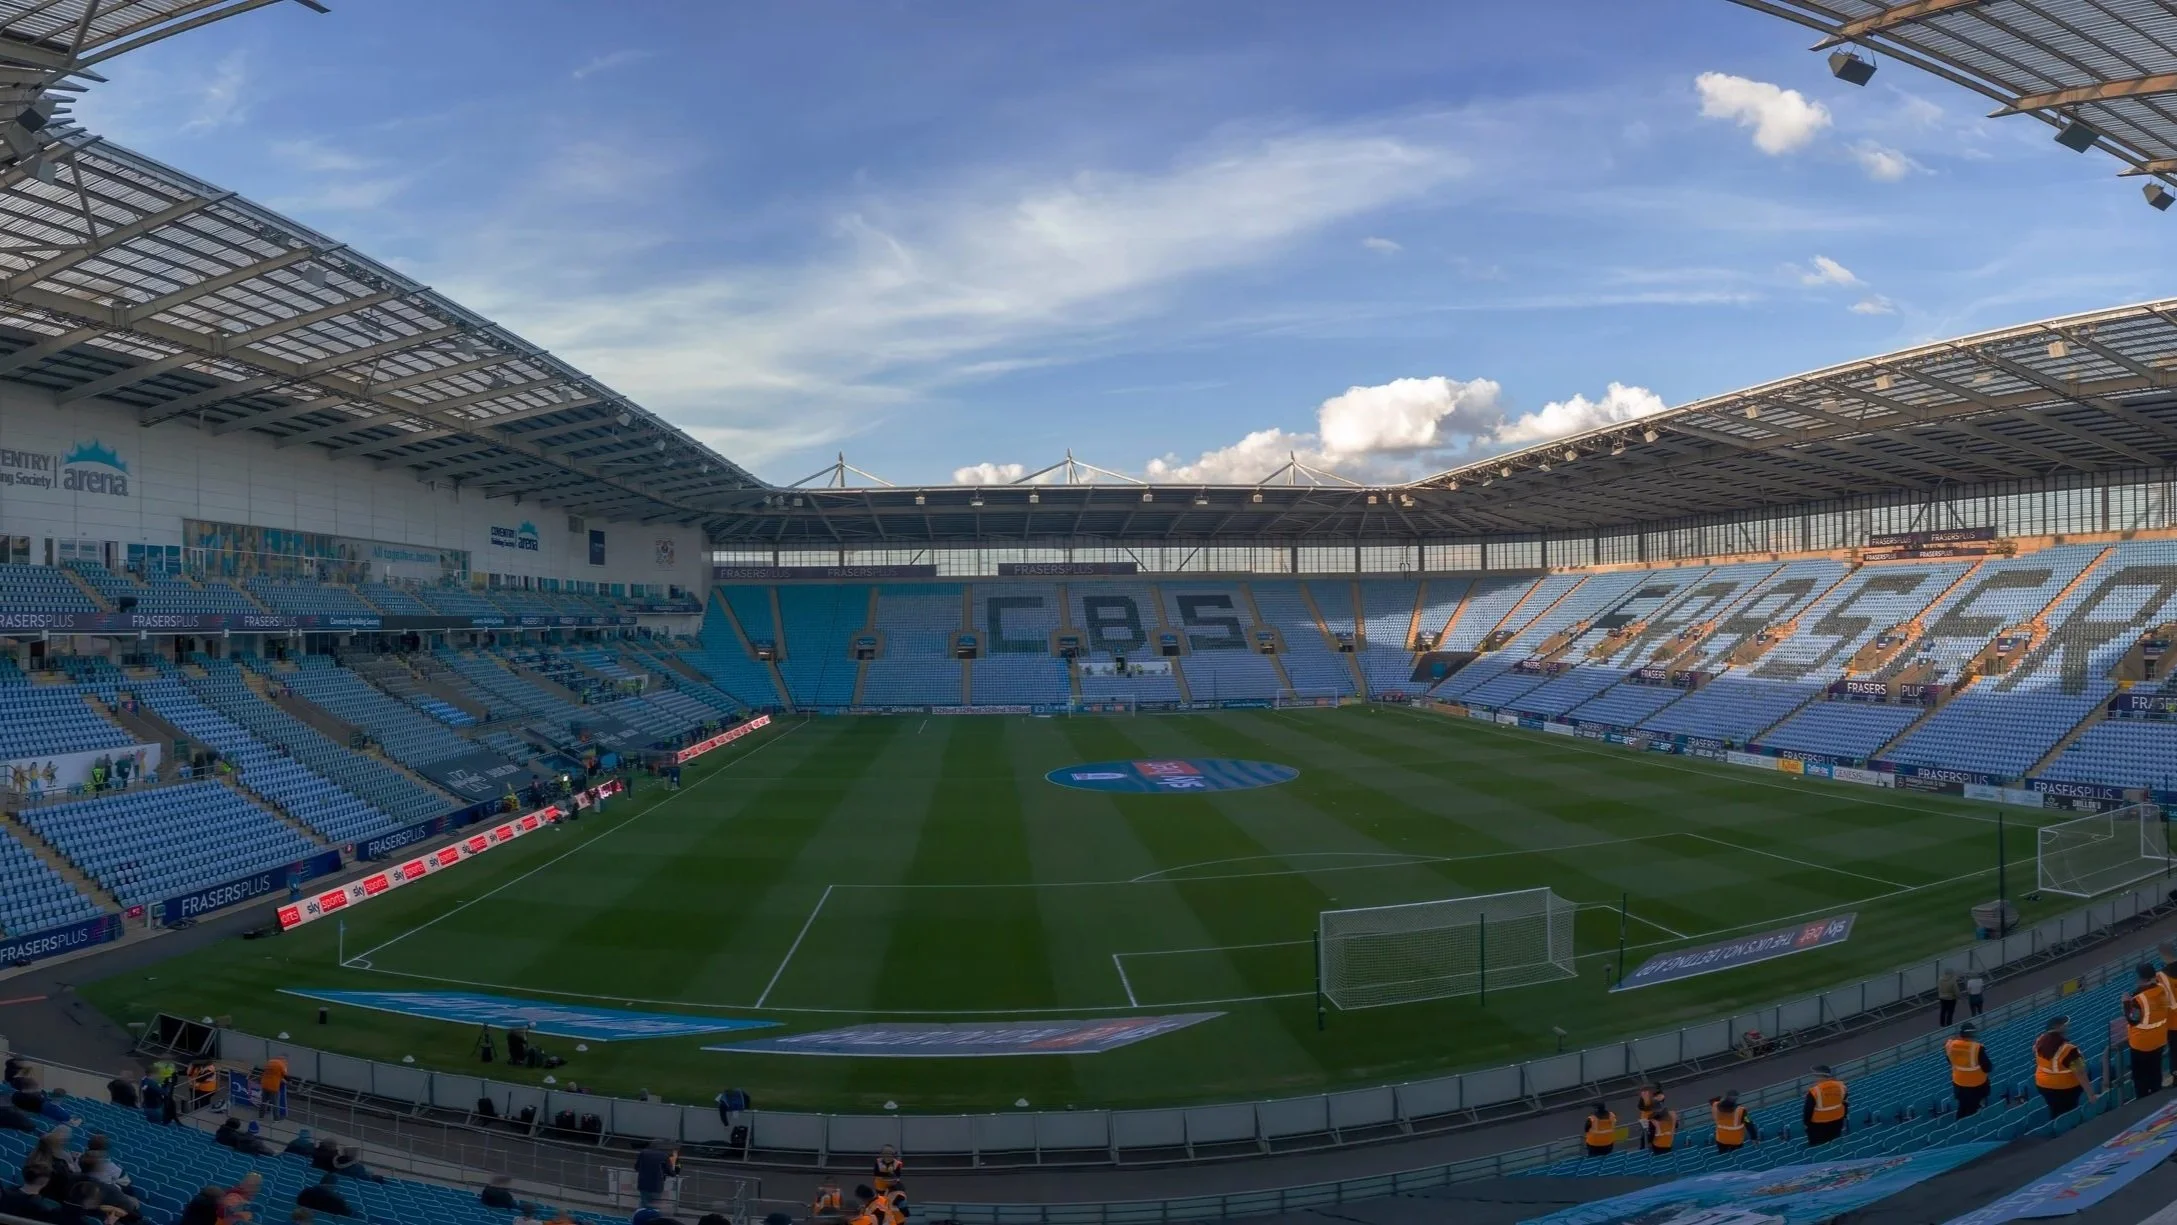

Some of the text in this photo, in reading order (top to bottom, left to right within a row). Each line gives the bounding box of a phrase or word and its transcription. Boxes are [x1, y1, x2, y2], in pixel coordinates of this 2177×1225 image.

[0, 449, 50, 471] ENTRY
[16, 472, 52, 490] Society
[64, 467, 129, 496] arena
[518, 537, 539, 551] arena
[1931, 531, 1976, 542] FRASERSPLUS
[720, 569, 791, 578] FRASERSPLUS
[828, 567, 898, 577] FRASERSPLUS
[1013, 563, 1093, 574] FRASERSPLUS
[132, 615, 200, 628] FRASERSPLUS
[244, 616, 298, 628] FRASERSPLUS
[986, 595, 1251, 653] CBS
[1641, 669, 1666, 680] FRASERS
[1847, 682, 1887, 695] FRASERS
[1783, 750, 1838, 766] FRASERSPLUS
[1917, 767, 1989, 786] FRASERSPLUS
[2034, 782, 2114, 800] FRASERSPLUS
[368, 826, 426, 857] FRASERSPLUS
[405, 861, 426, 879] sports
[429, 856, 439, 868] sky
[394, 870, 405, 882] sky
[353, 886, 365, 898] sky
[365, 876, 388, 894] sports
[181, 875, 271, 917] FRASERSPLUS
[321, 891, 347, 911] sports
[307, 902, 320, 915] sky
[1799, 927, 1824, 944] bet
[1823, 920, 1847, 938] sky
[0, 928, 88, 963] FRASERSPLUS
[1771, 932, 1795, 948] THE
[1662, 949, 1720, 972] BETTING
